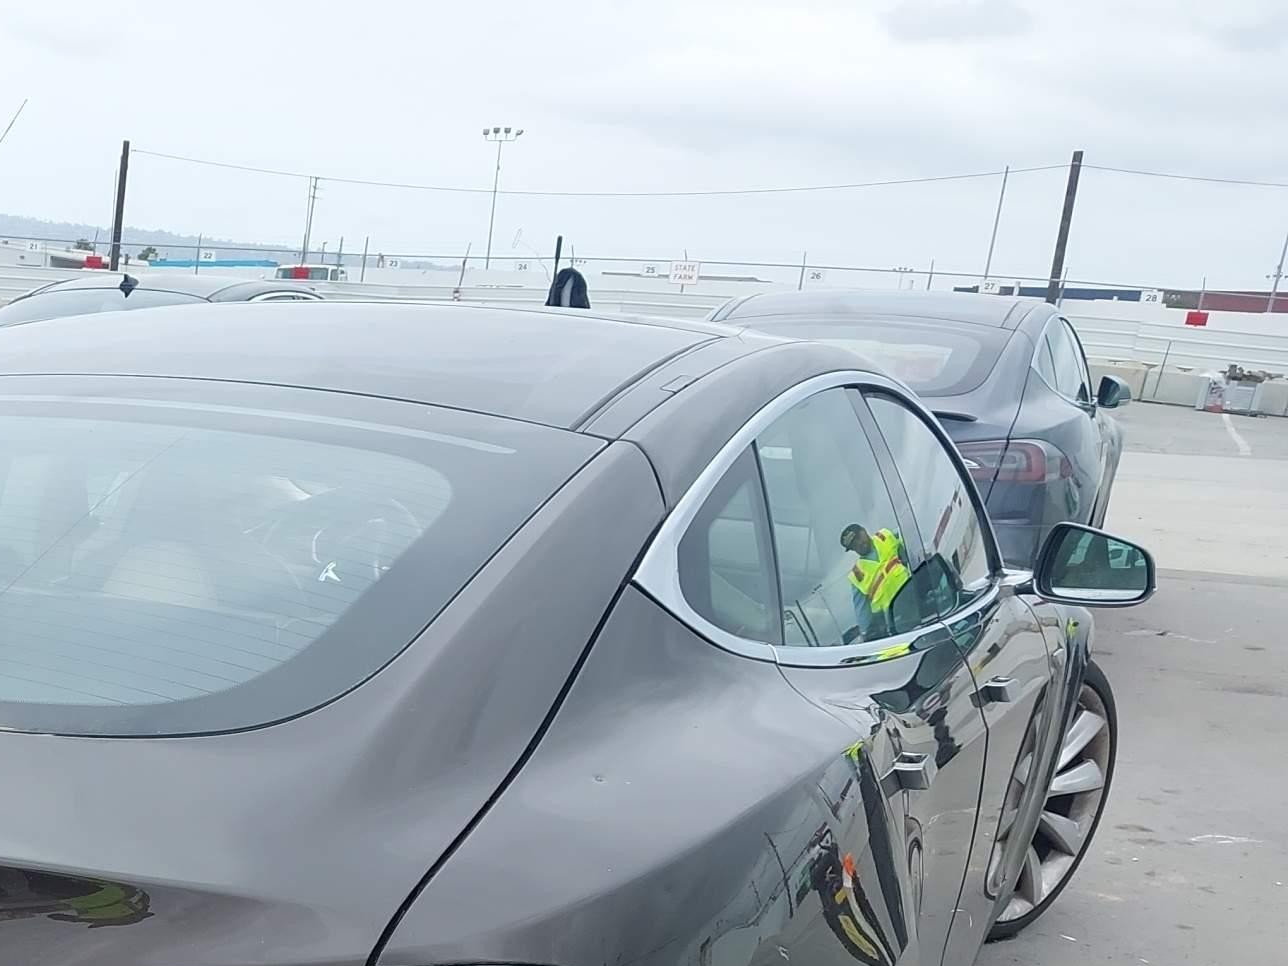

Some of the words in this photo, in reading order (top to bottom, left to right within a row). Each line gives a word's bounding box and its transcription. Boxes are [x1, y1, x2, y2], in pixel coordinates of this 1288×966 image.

[674, 264, 696, 272] STATE
[983, 281, 995, 291] 27
[1145, 293, 1158, 303] 28
